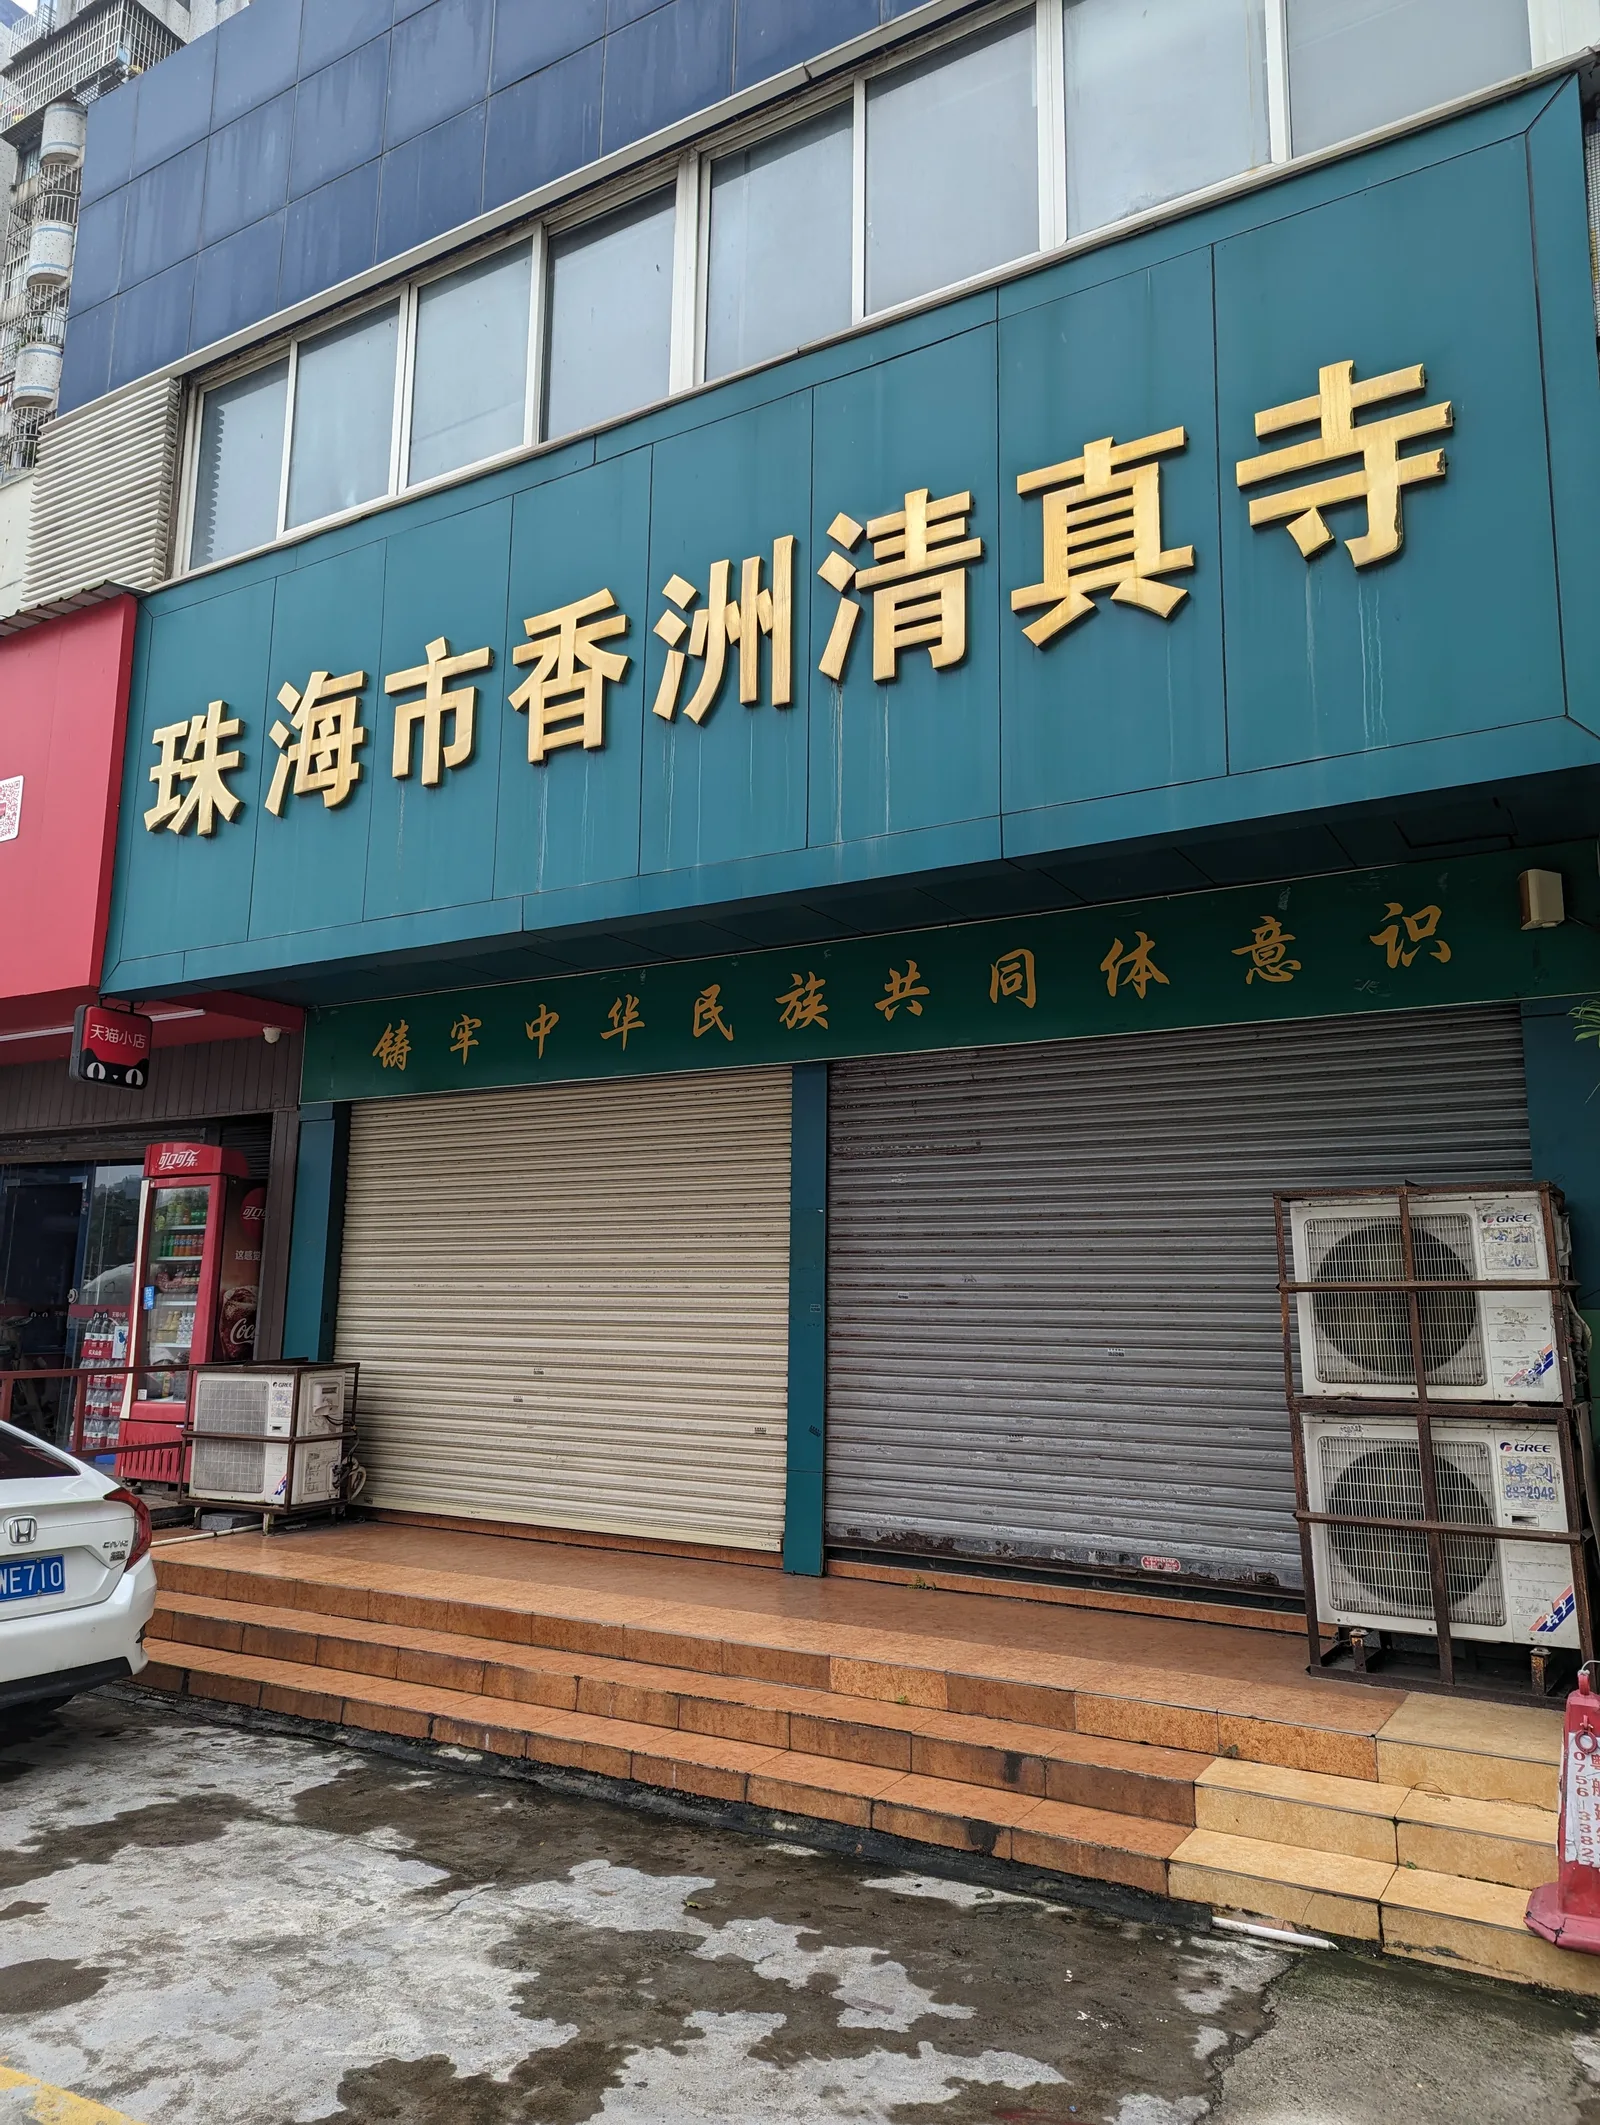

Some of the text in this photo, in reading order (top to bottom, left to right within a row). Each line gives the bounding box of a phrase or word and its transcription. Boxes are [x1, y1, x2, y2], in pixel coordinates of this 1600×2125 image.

[143, 359, 1454, 837] 珠海市香洲清真寺
[372, 902, 1452, 1072] 铸牢中华民族共同体意识
[90, 1024, 147, 1049] 天猫小店
[158, 1149, 201, 1170] 可口可乐
[1496, 1214, 1532, 1223] GREE
[1514, 1443, 1552, 1454] GREE
